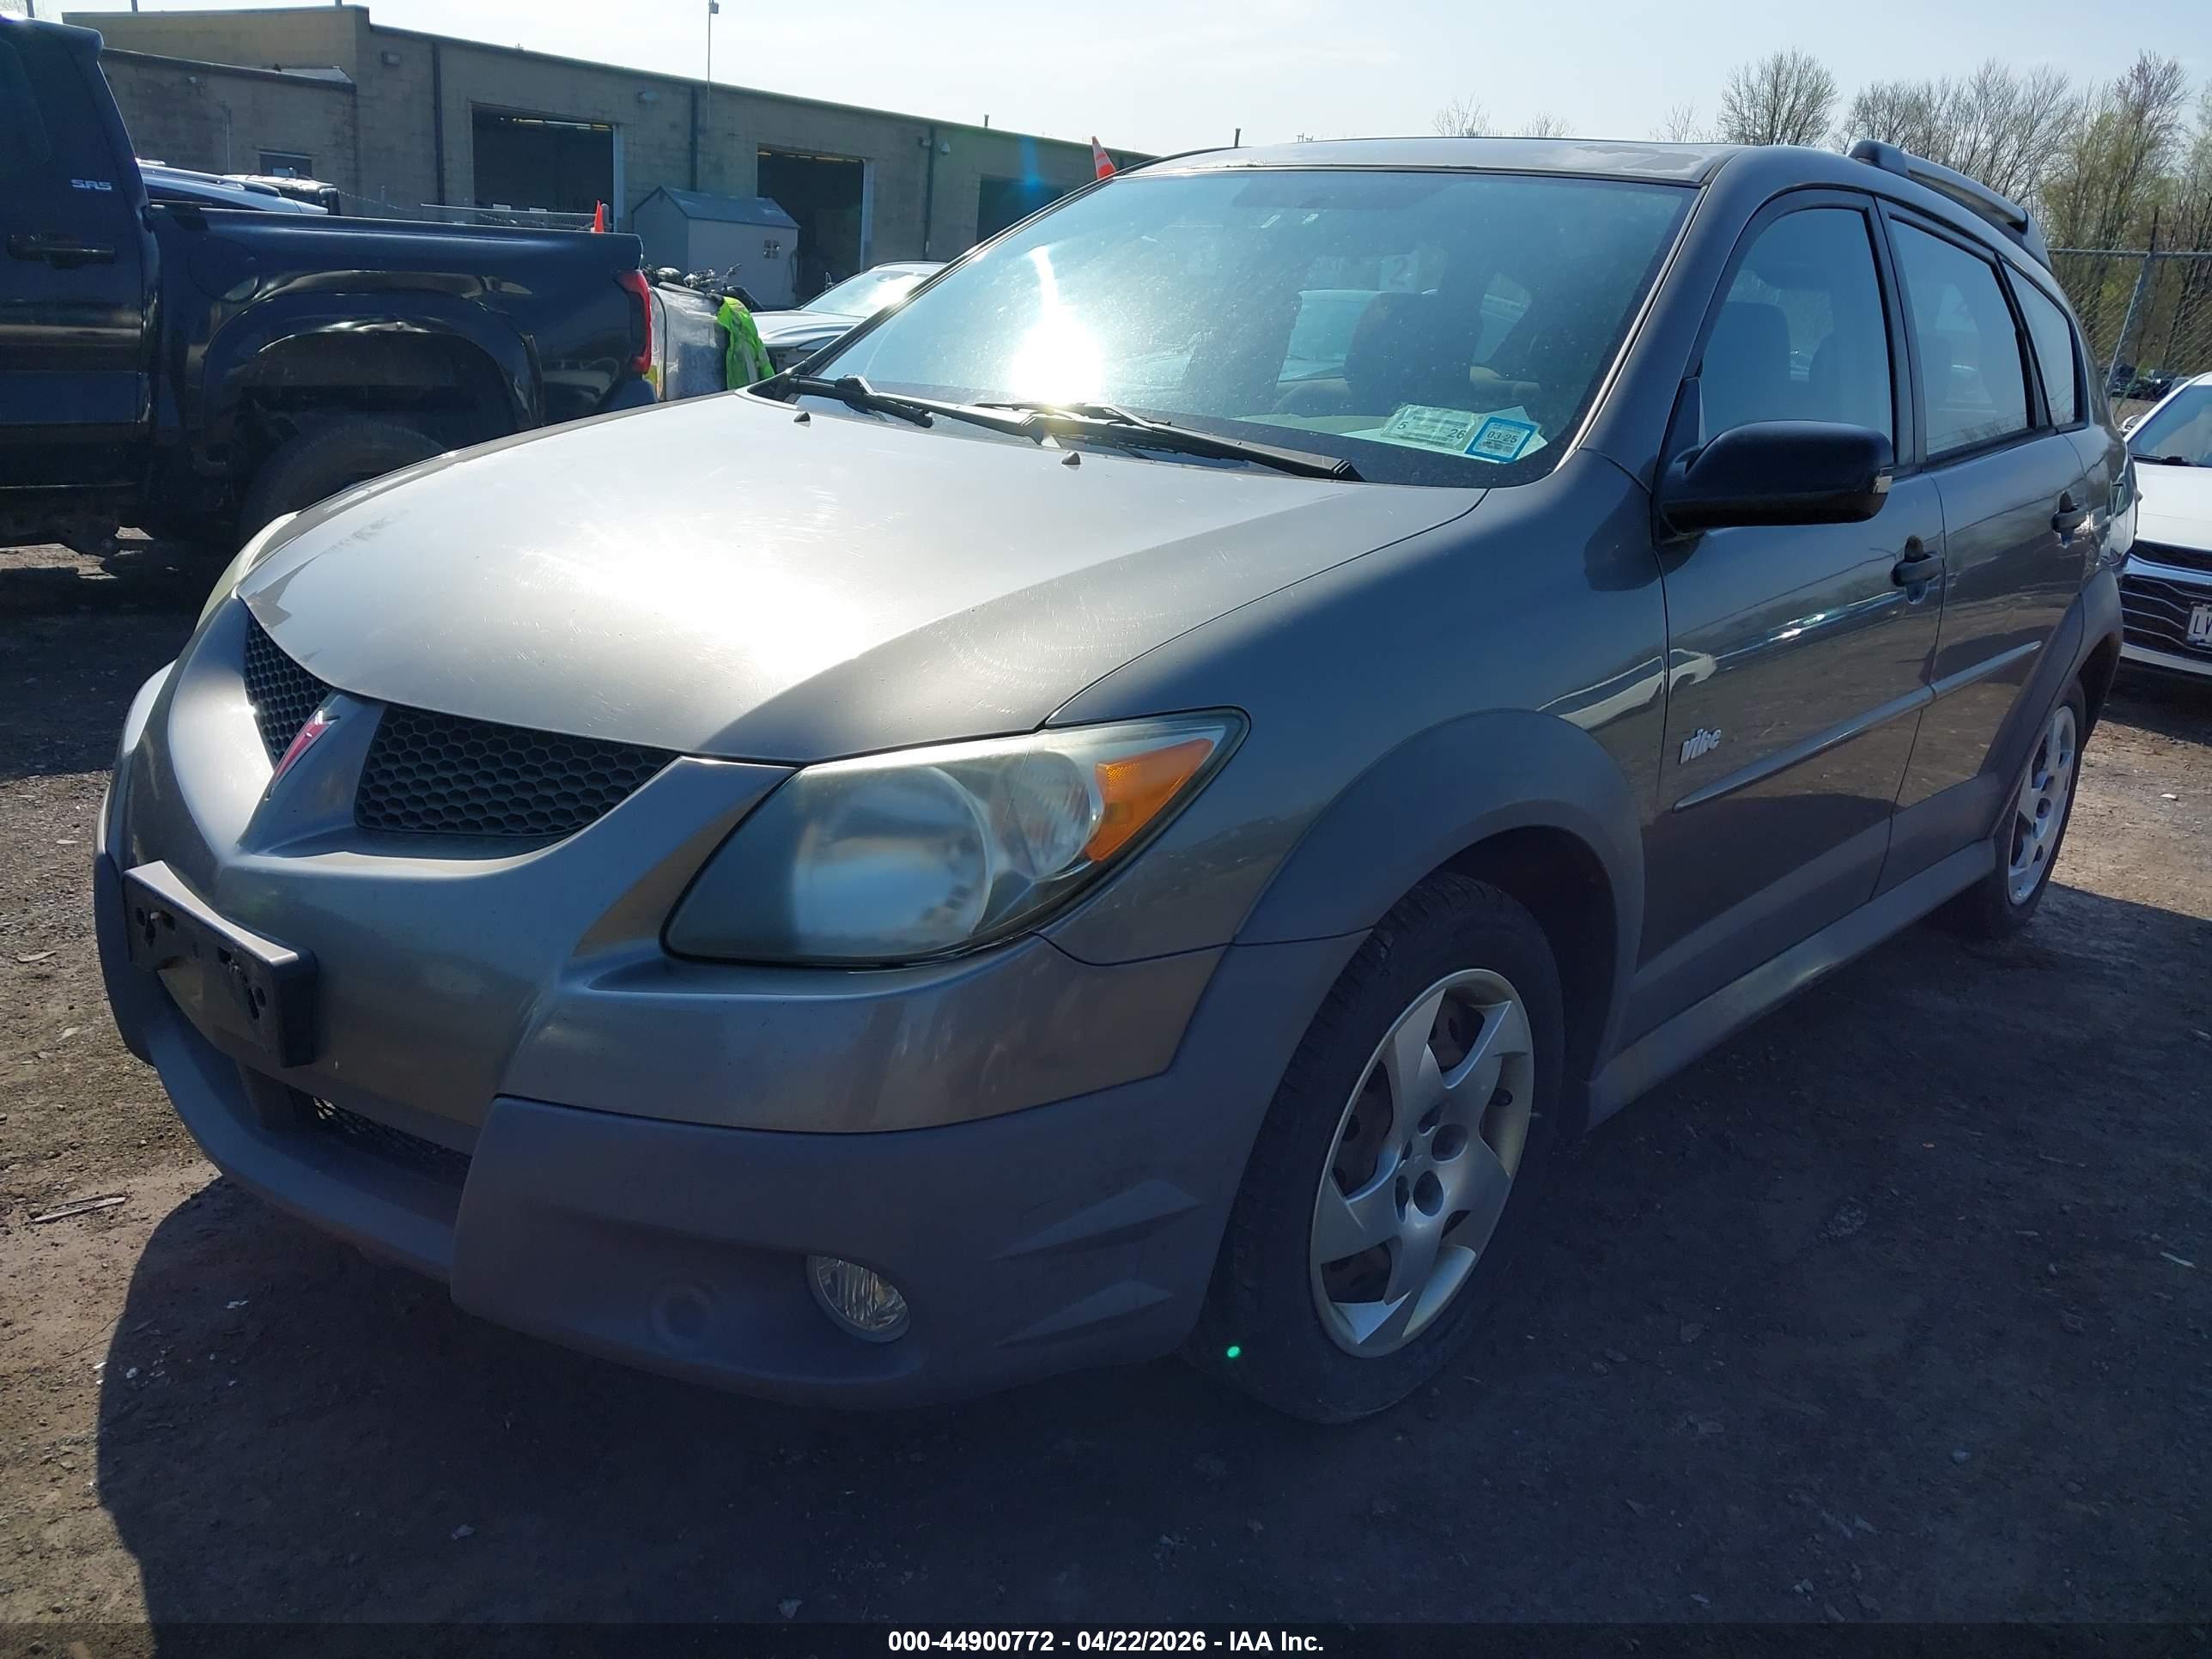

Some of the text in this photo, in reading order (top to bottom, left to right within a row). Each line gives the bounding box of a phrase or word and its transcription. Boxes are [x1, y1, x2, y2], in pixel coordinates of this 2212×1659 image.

[71, 179, 112, 191] SR5
[1397, 421, 1408, 430] 5
[1447, 428, 1467, 439] 26
